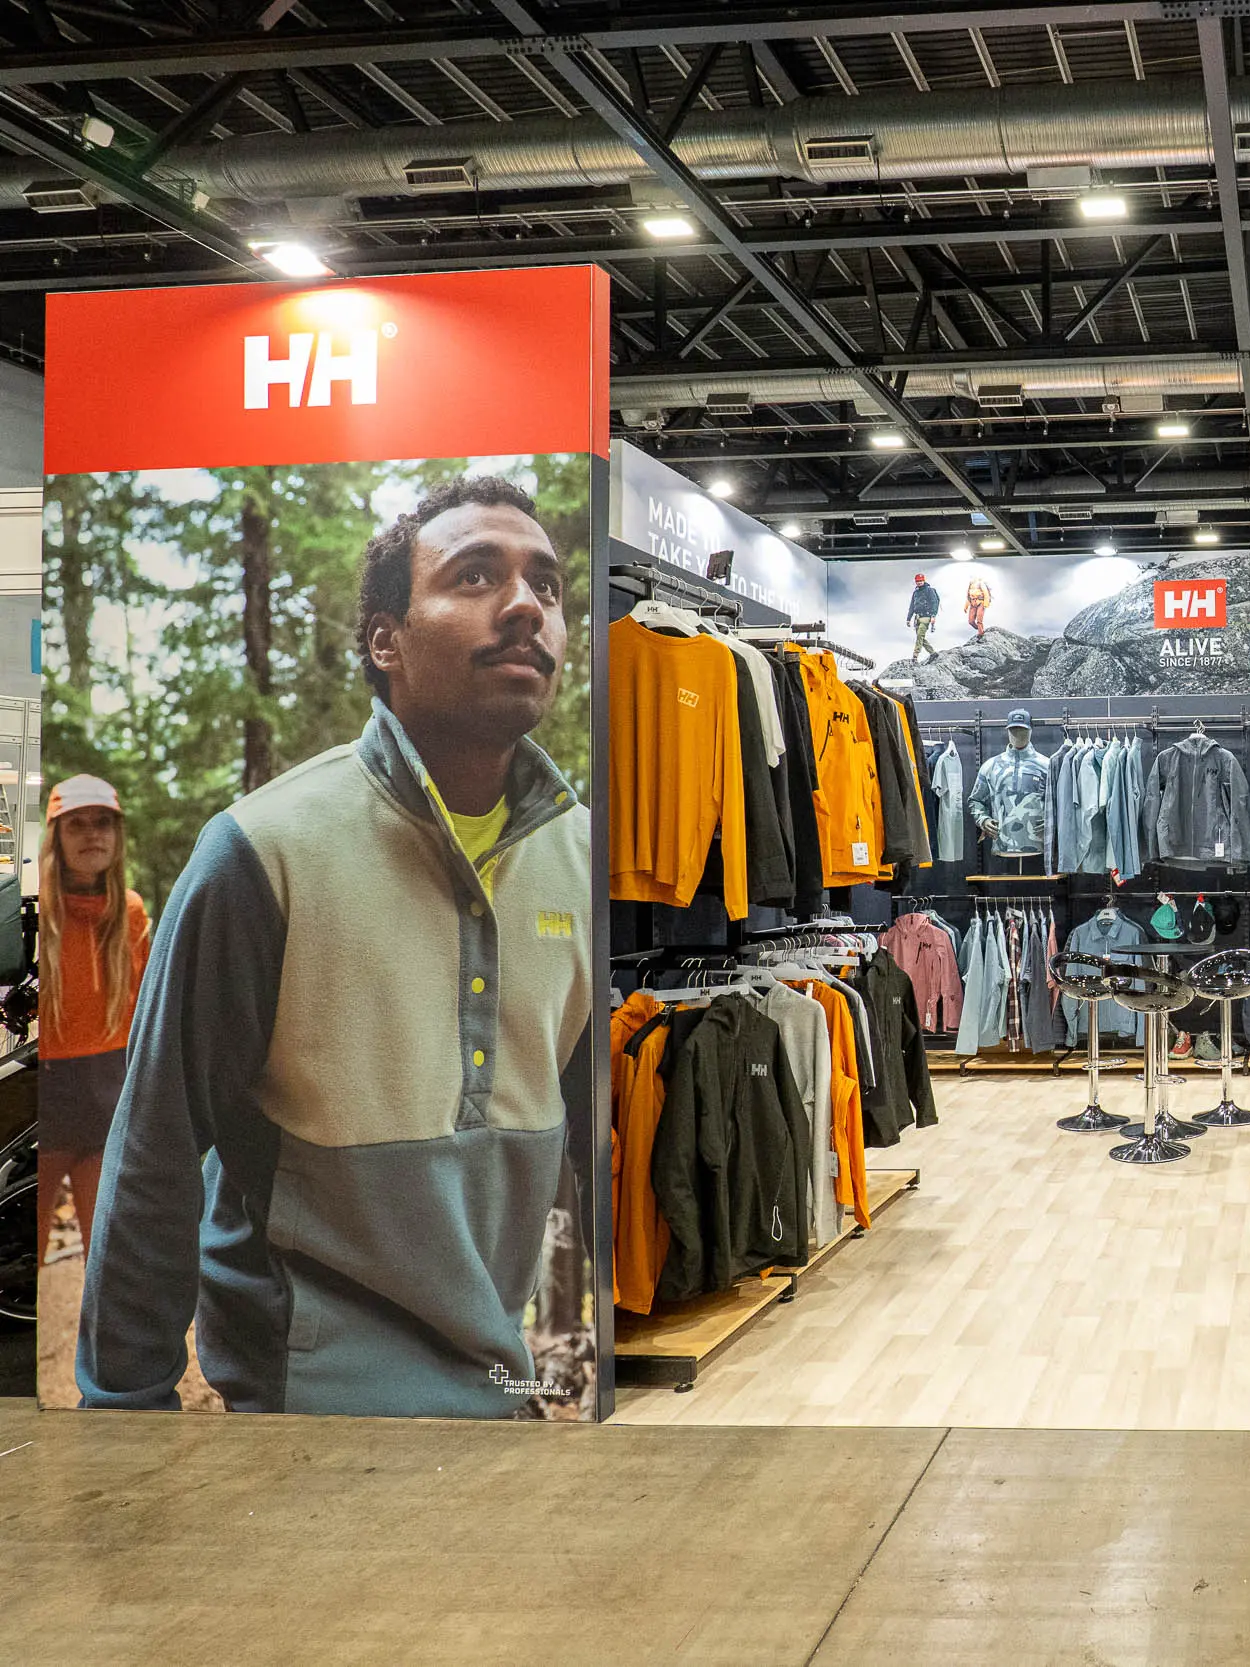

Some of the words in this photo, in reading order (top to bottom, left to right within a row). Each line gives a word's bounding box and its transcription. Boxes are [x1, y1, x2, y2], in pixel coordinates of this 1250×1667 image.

[648, 496, 697, 546] MADE
[648, 531, 692, 573] TAKE
[1164, 590, 1216, 618] HH
[1159, 637, 1223, 656] ALIVE
[1159, 657, 1192, 667] SINCE
[1200, 656, 1223, 666] 1877
[833, 711, 849, 724] HH
[751, 1064, 768, 1077] HH
[504, 1379, 541, 1388] TRUSTED
[543, 1380, 554, 1388] BY
[504, 1387, 571, 1396] PROFESSIONALS
